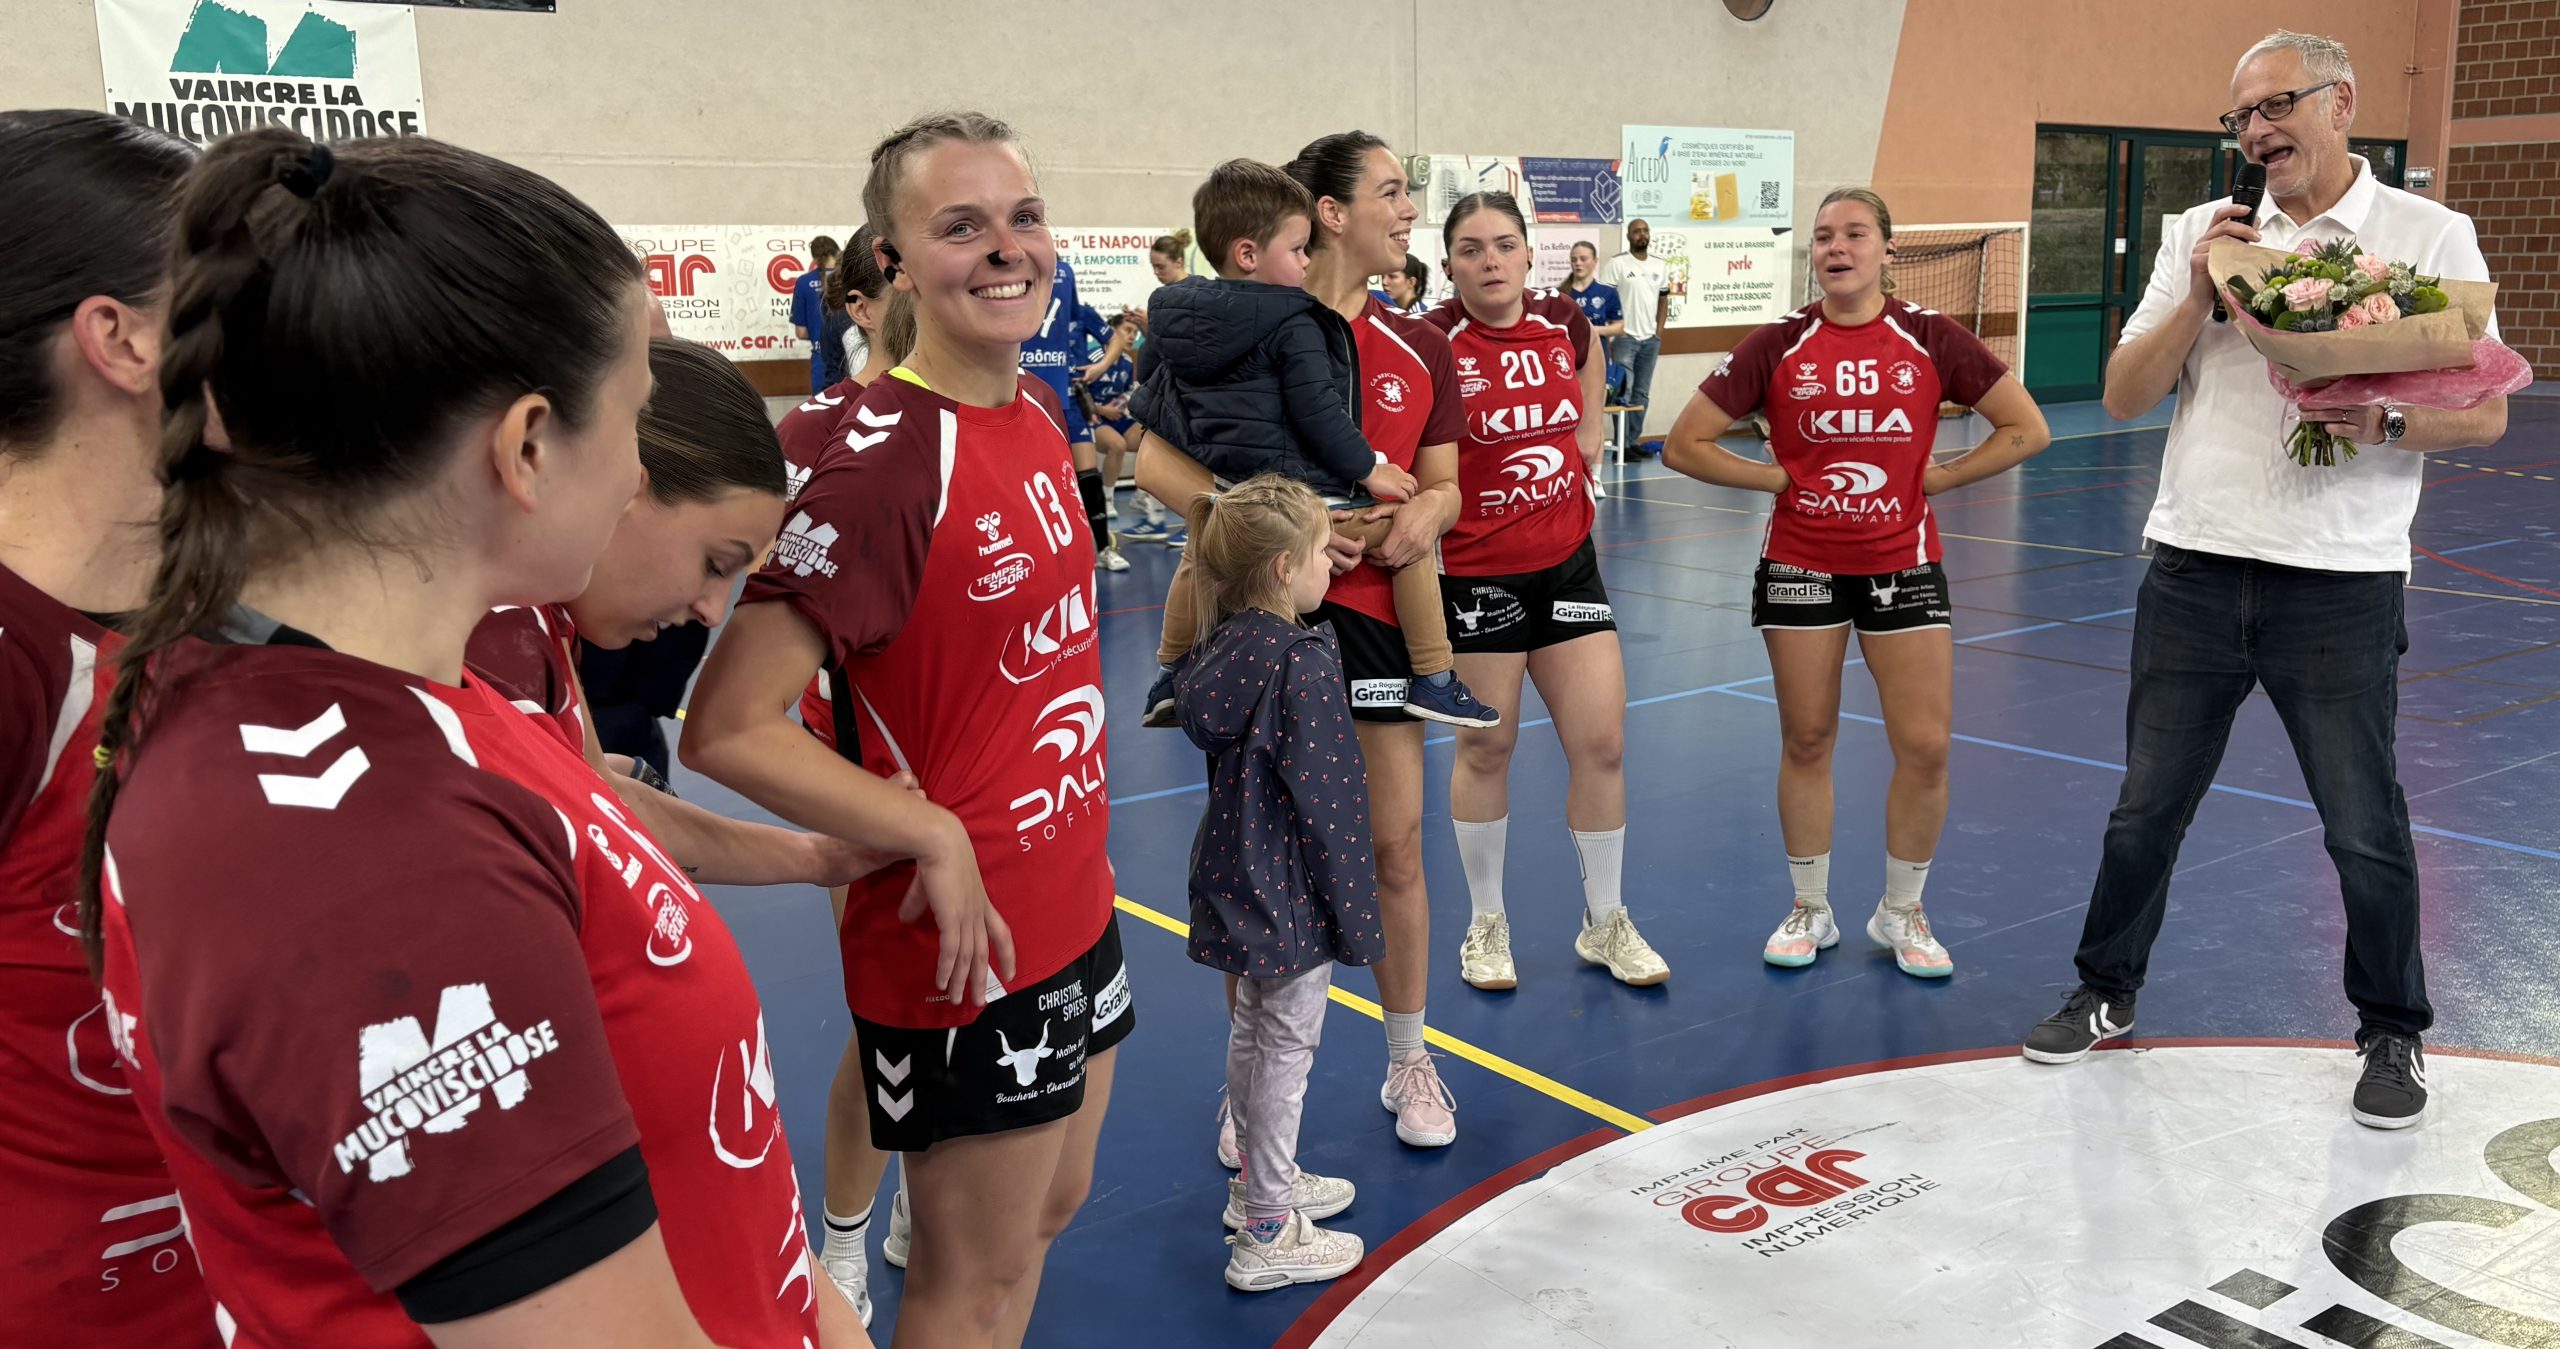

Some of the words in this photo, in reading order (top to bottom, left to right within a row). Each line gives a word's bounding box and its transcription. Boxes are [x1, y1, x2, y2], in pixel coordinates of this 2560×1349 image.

[169, 78, 315, 104] VAINCRE
[324, 85, 364, 106] LA
[1626, 141, 1669, 183] ALCEDO
[635, 239, 716, 252] OUPE
[1084, 255, 1139, 265] EMPORTER
[1727, 254, 1753, 276] perle
[644, 254, 716, 296] ar
[1712, 281, 1731, 291] place
[1732, 281, 1741, 290] de
[1725, 292, 1772, 301] STRASBOURG
[1500, 350, 1546, 389] 20
[1836, 359, 1880, 397] 65
[1023, 471, 1073, 555] 13
[1480, 488, 1573, 517] SOFTWAR
[1795, 504, 1903, 523] SOFTWARE
[1798, 490, 1902, 514] DALIM
[814, 543, 829, 557] LA
[978, 533, 1014, 557] hummel
[976, 559, 1023, 587] TEMPS2
[988, 567, 1030, 593] SPORT
[1769, 563, 1805, 574] FITNESS
[1768, 584, 1807, 596] Grand
[1810, 584, 1831, 596] Est
[1555, 607, 1600, 621] Grand
[1601, 610, 1614, 622] Es
[1354, 686, 1406, 701] Grand
[1010, 752, 1106, 832] DALI
[1020, 789, 1107, 852] SOFTW
[1038, 979, 1084, 1012] CHRISTINE
[1063, 995, 1088, 1022] SPIESS
[1056, 1043, 1077, 1060] Maître
[362, 1039, 477, 1114] VAINCRE
[475, 1021, 511, 1050] LA
[333, 1019, 559, 1174] MUCOVISCIDOSE
[996, 1089, 1039, 1104] Boucherie
[1754, 1127, 1809, 1149] PAR
[1653, 1135, 1834, 1207] GROUPE
[1681, 1149, 1871, 1233] car
[1741, 1173, 1923, 1249] IMPRESSION
[1758, 1179, 1942, 1258] NUMERIQUE
